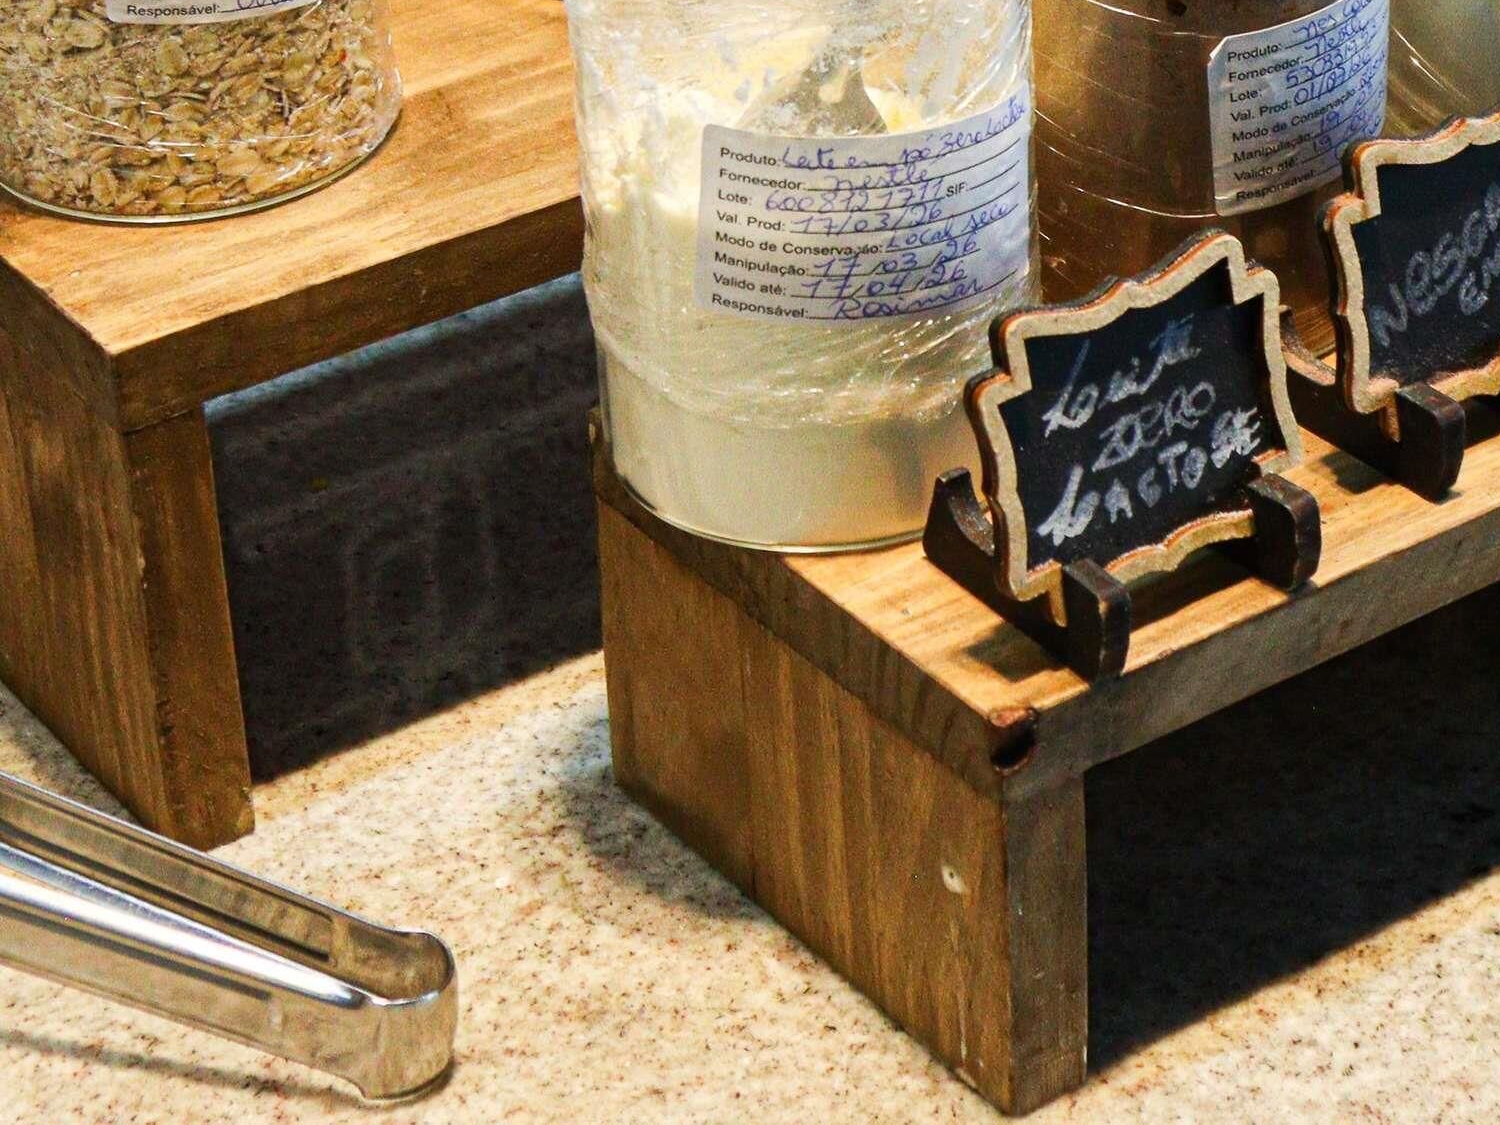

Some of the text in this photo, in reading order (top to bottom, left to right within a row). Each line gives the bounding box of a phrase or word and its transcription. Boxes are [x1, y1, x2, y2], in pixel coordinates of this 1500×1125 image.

[126, 3, 220, 17] Responsável:
[1227, 42, 1283, 63] Produto:
[1228, 56, 1305, 83] Fornecedor:
[1230, 88, 1263, 103] Lote:
[1260, 100, 1293, 117] Prod:
[1233, 125, 1268, 143] Modo
[1272, 122, 1288, 134] de
[720, 147, 781, 167] Produto:
[1232, 130, 1315, 163] Manipulação:
[719, 168, 806, 191] Fornecedor:
[718, 189, 752, 205] Lote:
[716, 210, 742, 223] Val.
[747, 216, 785, 232] Prod:
[715, 231, 755, 249] Modo
[759, 240, 777, 253] de
[714, 251, 810, 276] Manipulação:
[713, 272, 756, 292] Valido
[760, 283, 788, 296] até:
[711, 293, 810, 318] Responsável:
